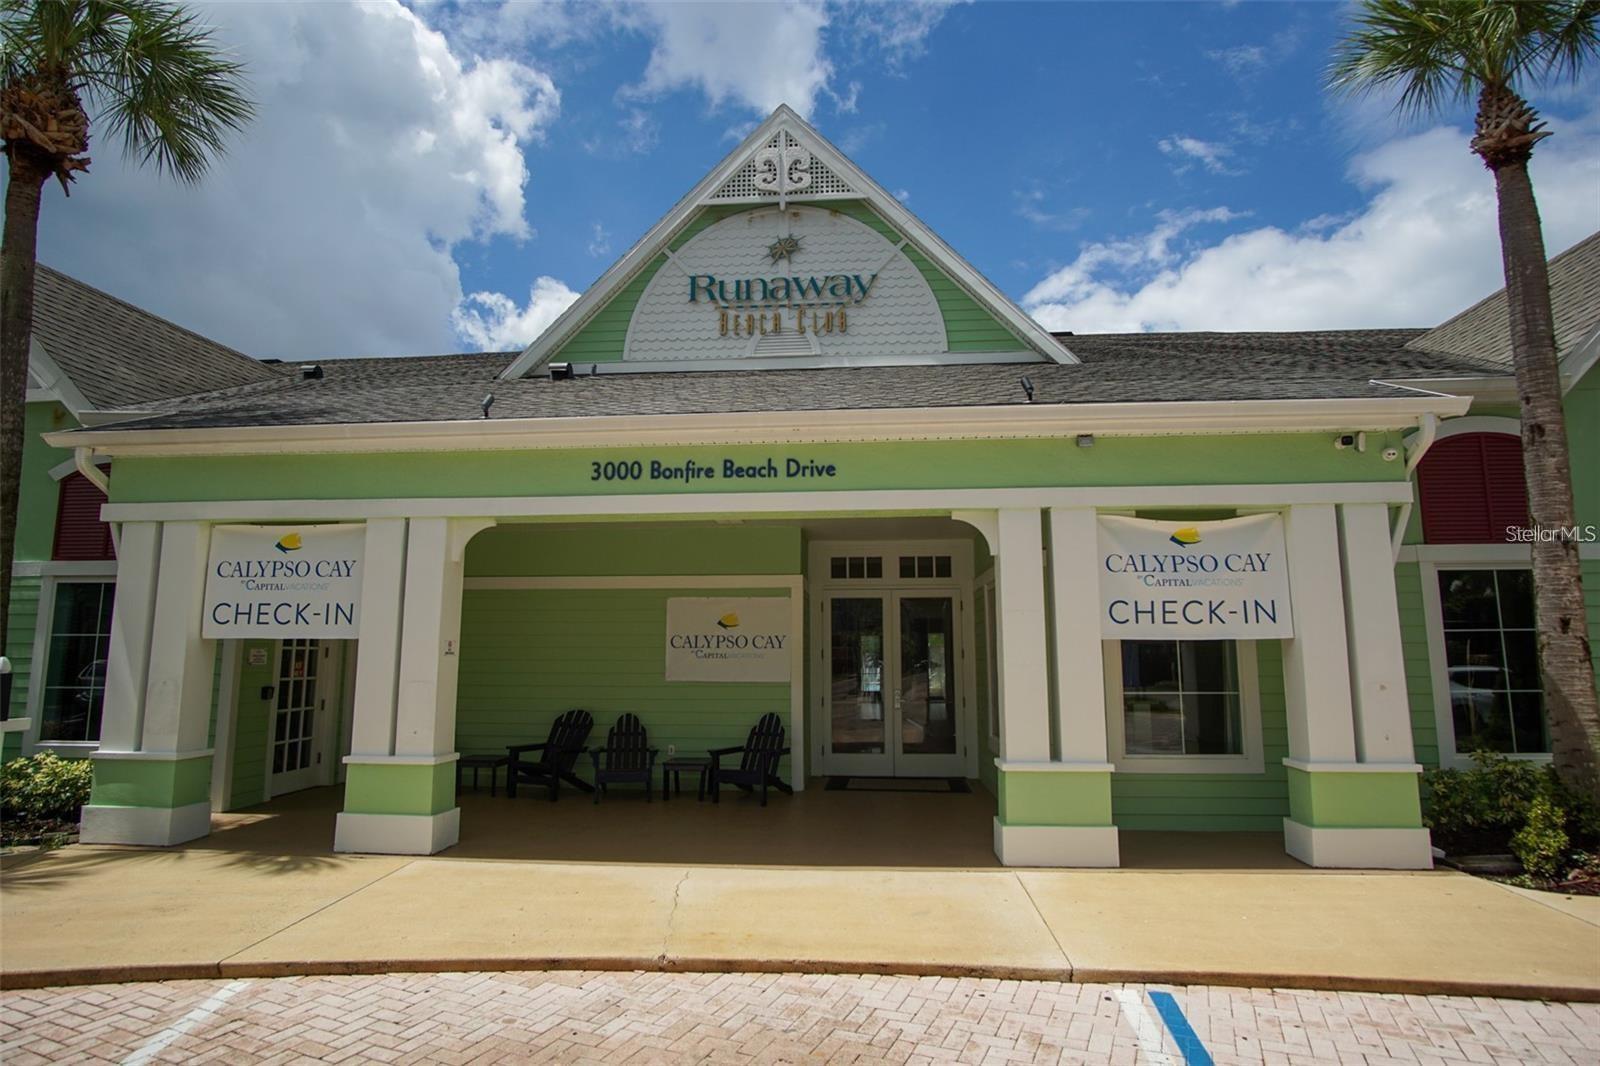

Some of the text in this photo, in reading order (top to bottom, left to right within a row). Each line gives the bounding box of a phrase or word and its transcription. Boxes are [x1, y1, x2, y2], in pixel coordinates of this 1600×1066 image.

[688, 273, 878, 304] Runaway
[719, 310, 782, 336] BEACH
[590, 457, 837, 483] 3000 Bonfire Beach Drive
[217, 559, 357, 578] CALYPSO CAY
[1105, 553, 1271, 573] CALYPSO CAY
[212, 602, 354, 625] CHECK-IN
[1108, 600, 1277, 625] CHECK-IN
[670, 634, 787, 649] CALYPSO CAY
